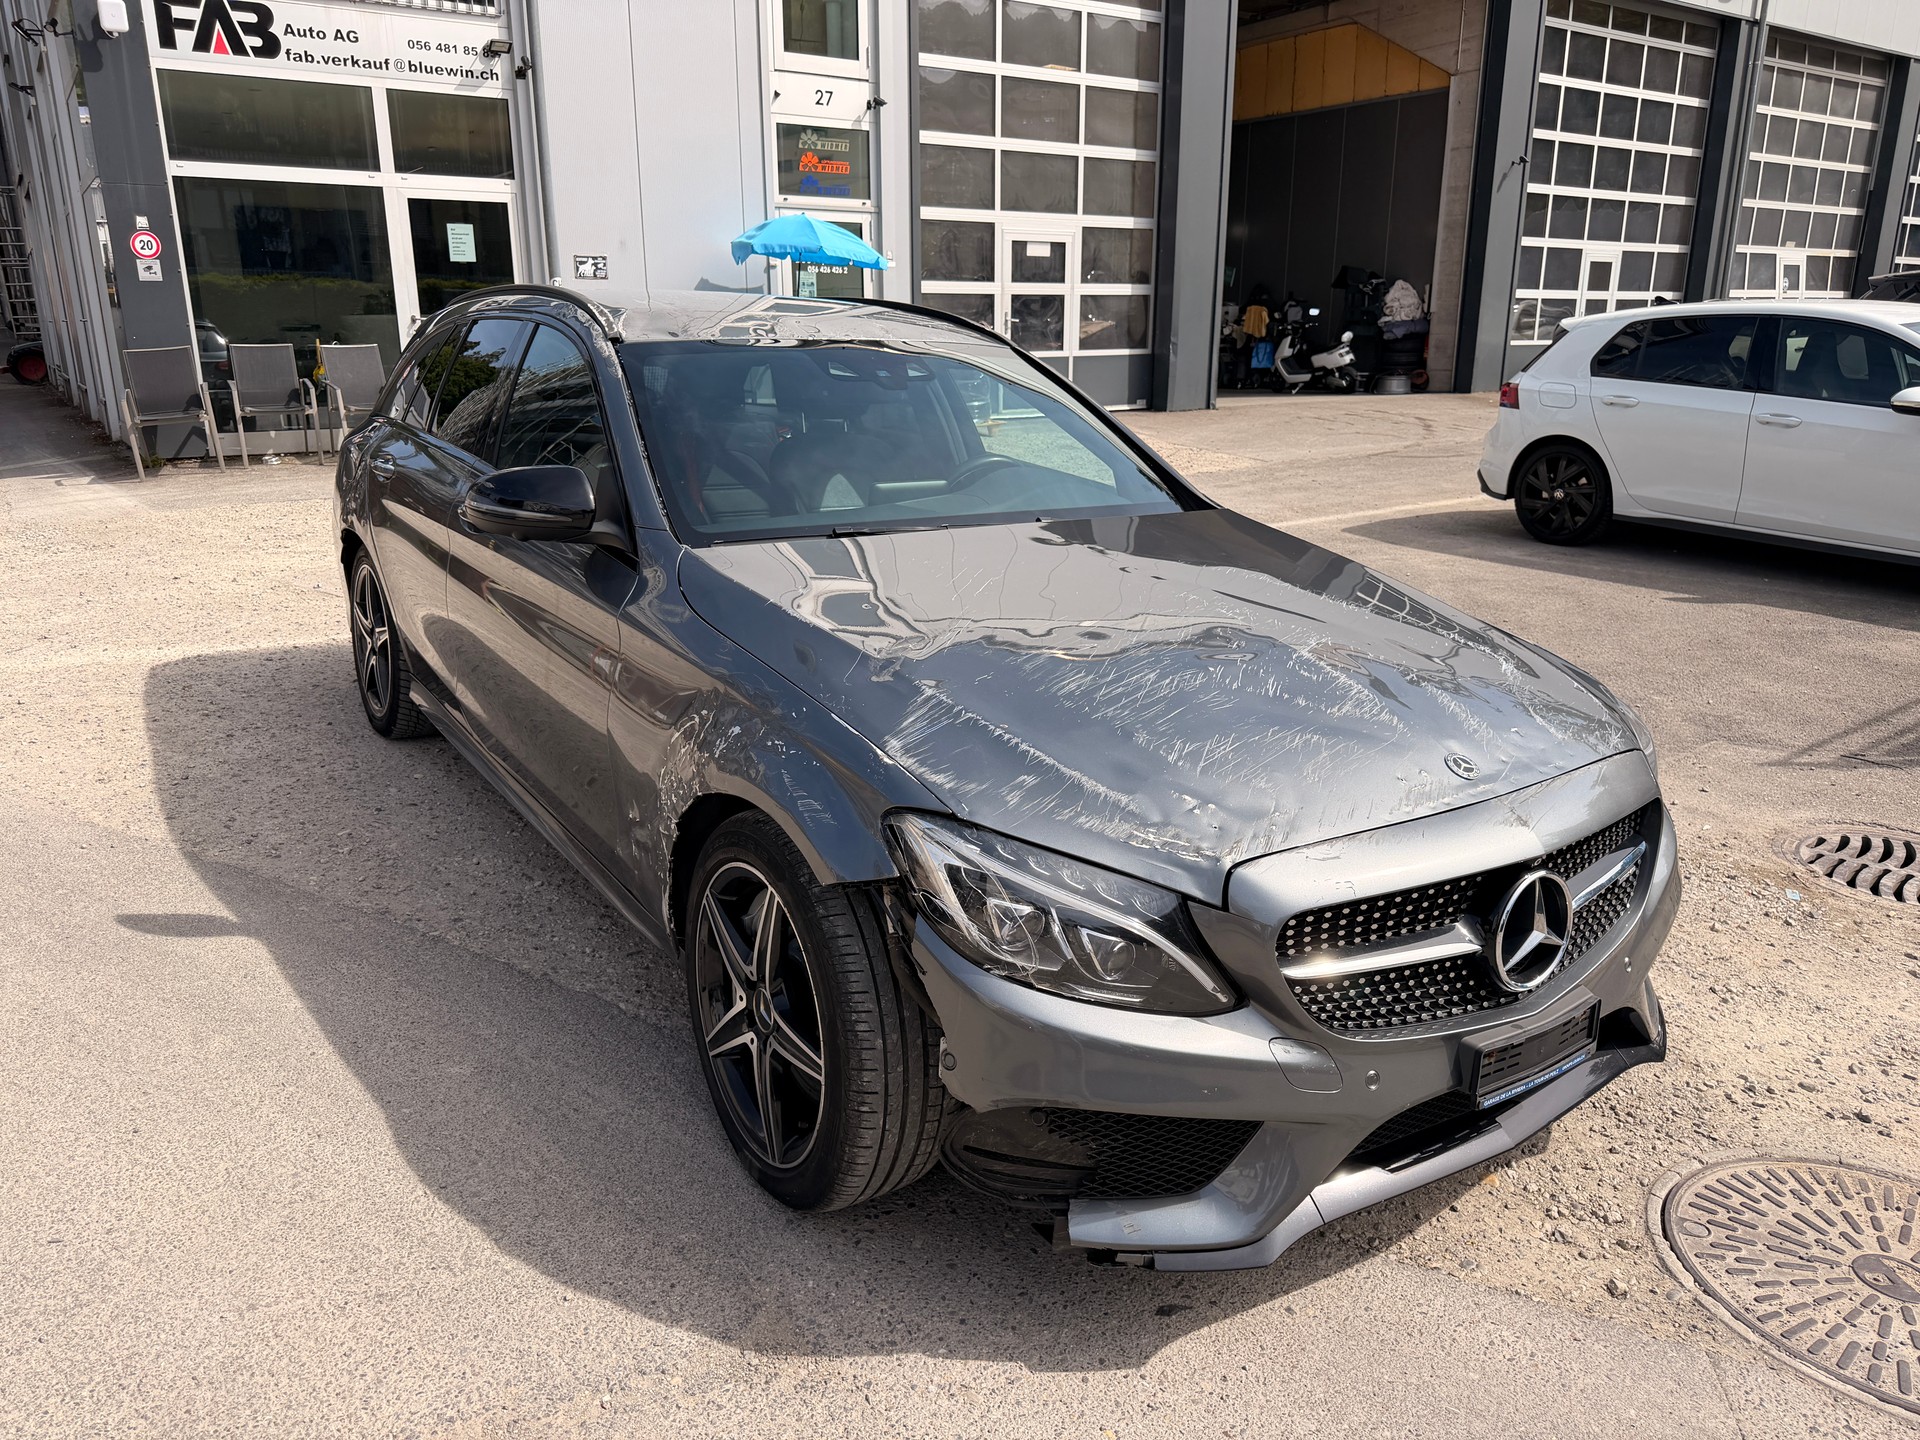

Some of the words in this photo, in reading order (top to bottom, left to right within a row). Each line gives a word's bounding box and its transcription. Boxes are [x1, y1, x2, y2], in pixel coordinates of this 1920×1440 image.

[153, 0, 282, 60] FAB
[283, 23, 327, 41] Auto
[333, 28, 359, 44] AG
[407, 39, 432, 52] 056
[435, 42, 458, 54] 481
[463, 45, 478, 57] 85
[815, 89, 834, 106] 27
[820, 141, 848, 151] WIDMER
[821, 163, 849, 174] WIDMER
[139, 239, 153, 251] 20
[807, 265, 819, 274] 056
[843, 266, 849, 275] 2
[1483, 1095, 1500, 1107] GARAGE
